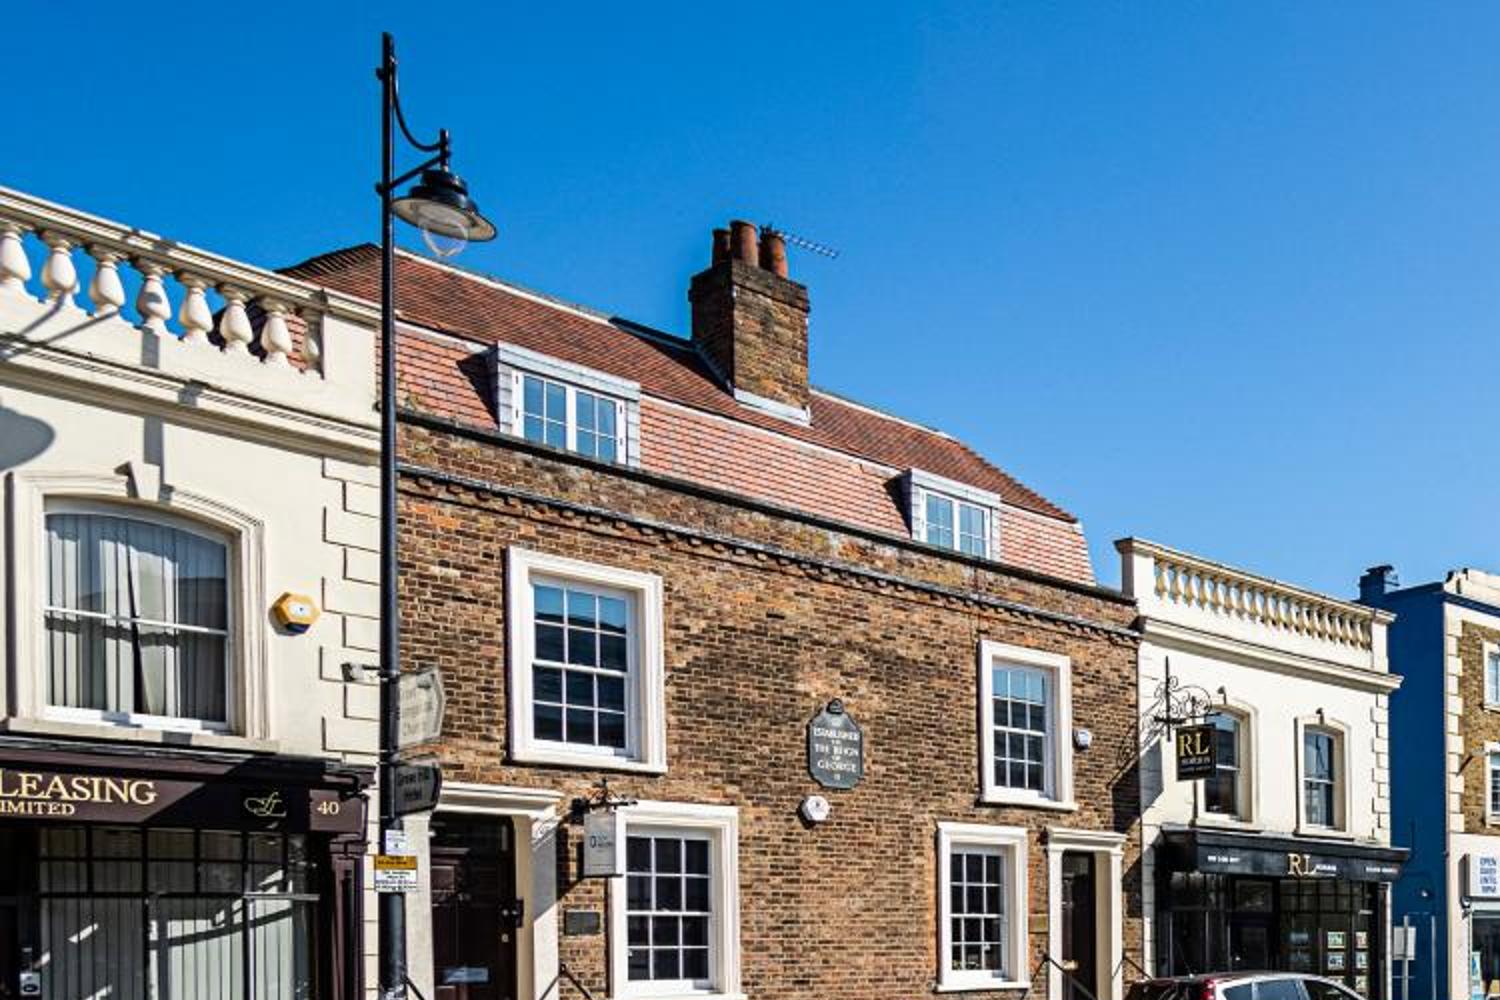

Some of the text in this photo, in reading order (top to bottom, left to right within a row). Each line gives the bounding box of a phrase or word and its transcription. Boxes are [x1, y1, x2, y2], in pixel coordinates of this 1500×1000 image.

[1179, 733, 1210, 757] RL
[0, 768, 158, 805] LEASING
[0, 801, 76, 816] IMITED
[317, 801, 340, 815] 40
[1287, 853, 1316, 877] RL
